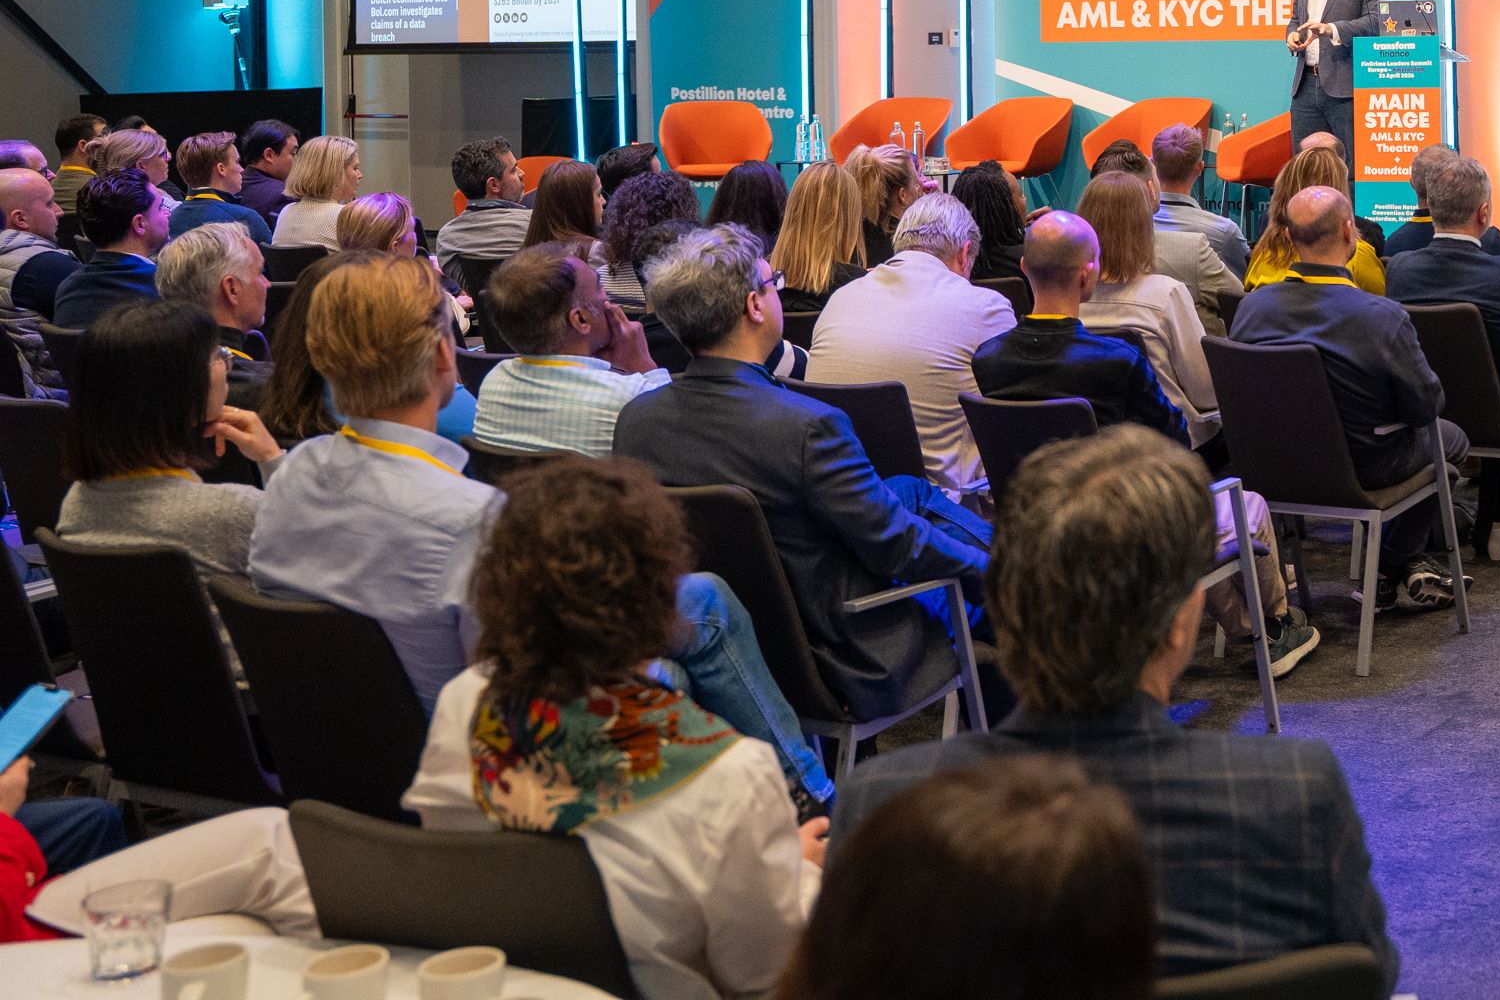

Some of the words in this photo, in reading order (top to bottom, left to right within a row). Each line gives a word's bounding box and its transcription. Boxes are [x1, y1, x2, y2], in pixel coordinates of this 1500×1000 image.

[371, 6, 399, 17] Bol.com
[400, 5, 443, 18] investigates
[1056, 1, 1125, 29] AML
[1131, 0, 1152, 28] &
[371, 19, 394, 30] claims
[395, 18, 402, 29] of
[403, 21, 408, 29] a
[409, 18, 426, 29] data
[371, 31, 395, 42] breach
[1373, 41, 1416, 50] transform
[1379, 49, 1410, 58] finance
[671, 86, 735, 101] Postillion
[737, 87, 775, 101] Hotel
[776, 87, 786, 101] &
[1369, 94, 1425, 110] MAIN
[1365, 111, 1430, 129] STAGE
[1370, 132, 1393, 141] AML
[1394, 132, 1401, 141] &
[1403, 132, 1425, 141] KYC
[1376, 143, 1419, 153] Theatre
[1364, 166, 1411, 176] Roundta
